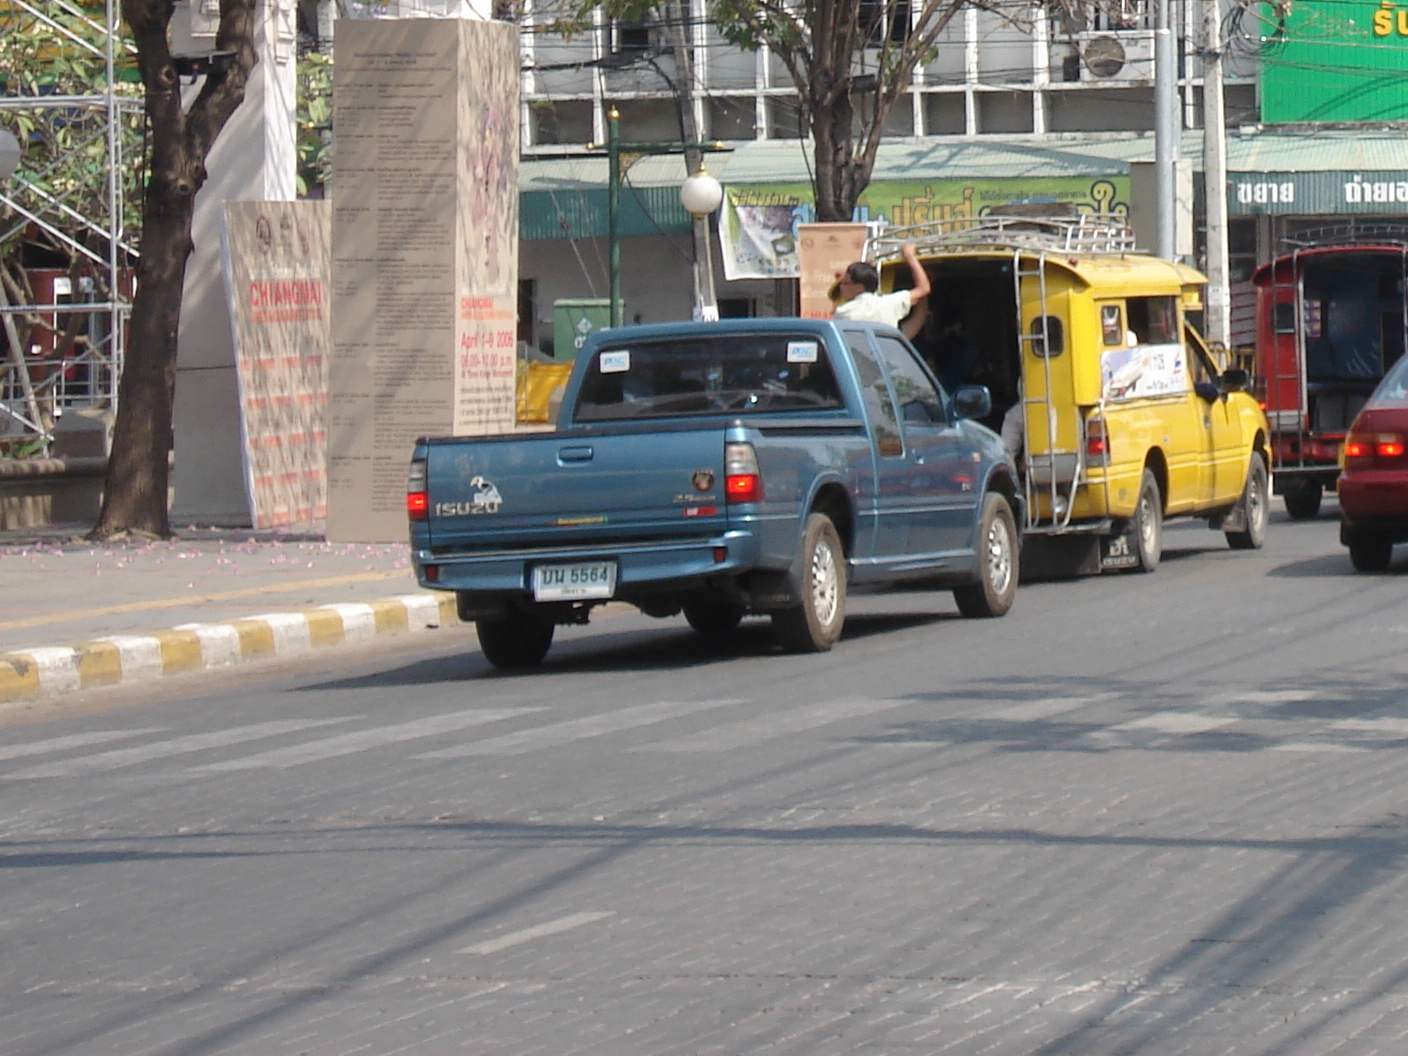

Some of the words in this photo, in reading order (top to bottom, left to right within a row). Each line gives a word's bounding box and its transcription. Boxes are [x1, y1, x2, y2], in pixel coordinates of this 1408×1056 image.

[1237, 182, 1294, 204] ขยาย
[250, 281, 322, 307] CHIANGMAI
[461, 332, 478, 349] April
[435, 501, 499, 517] ISUZU
[571, 567, 608, 583] 5564
